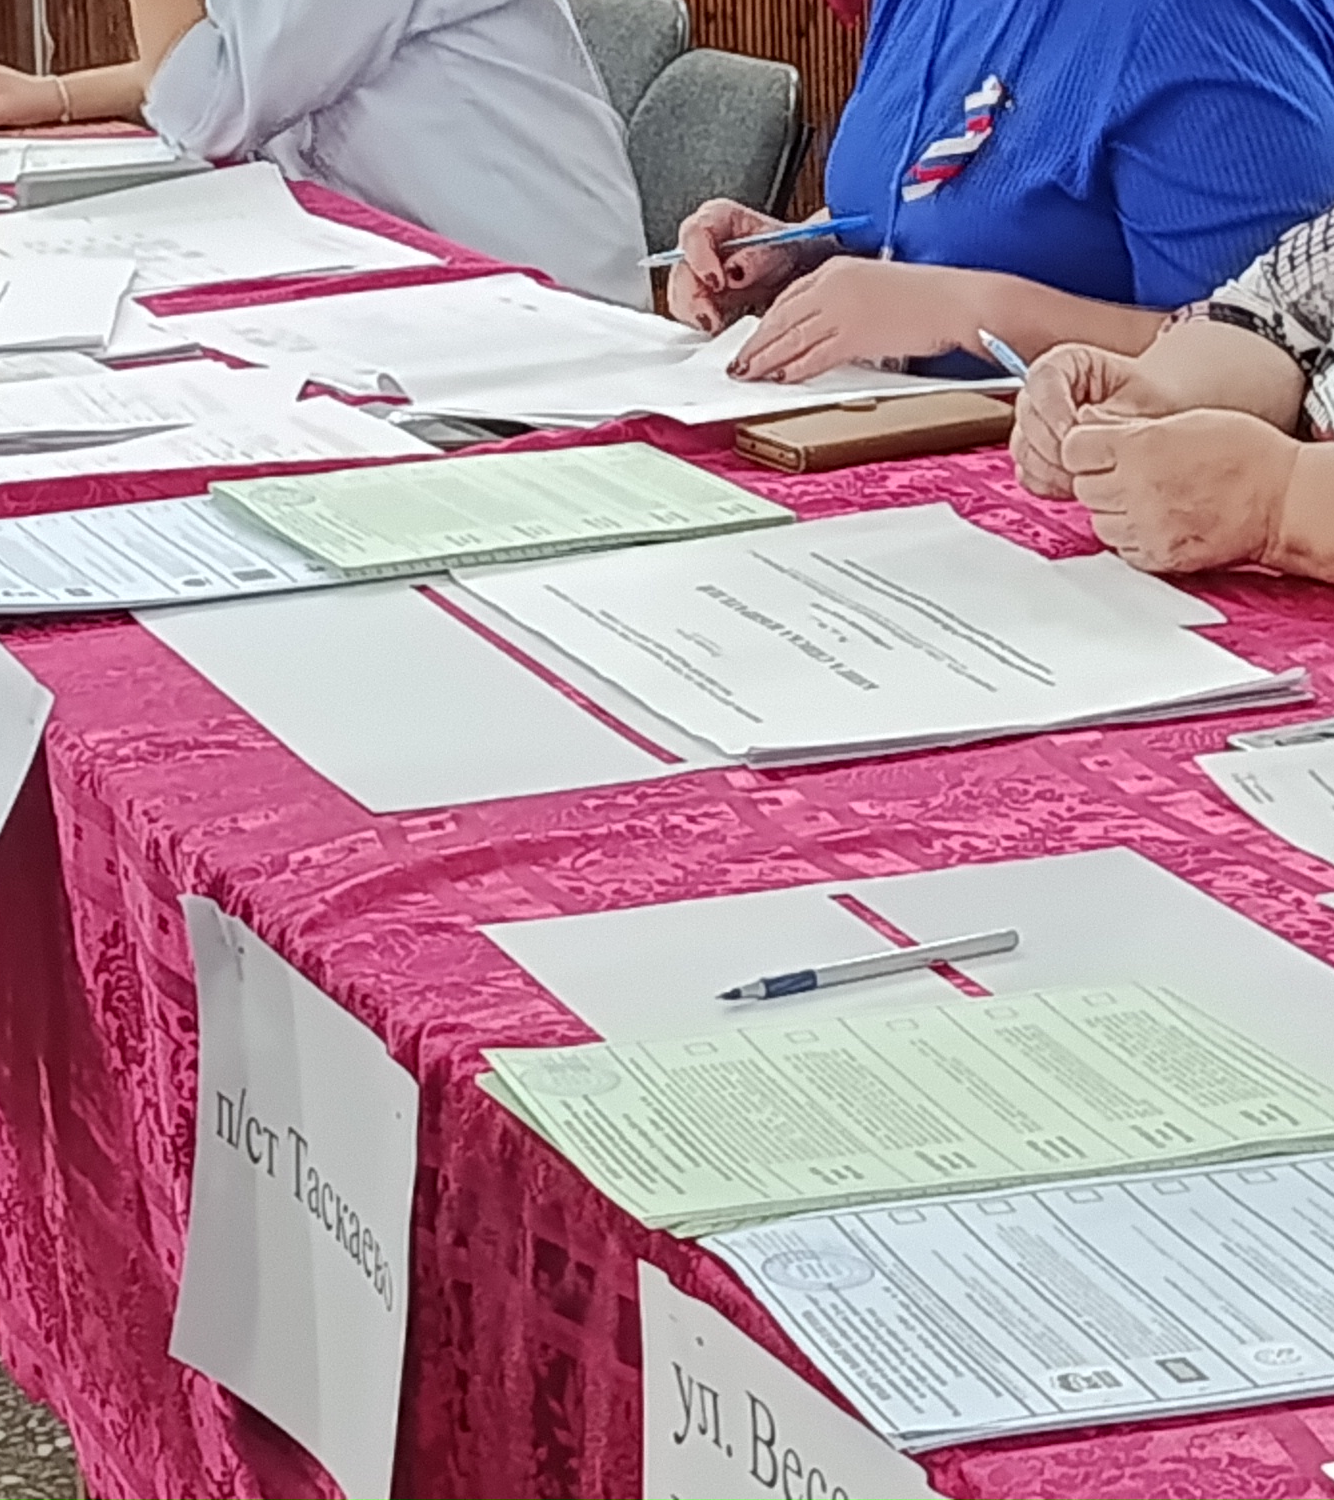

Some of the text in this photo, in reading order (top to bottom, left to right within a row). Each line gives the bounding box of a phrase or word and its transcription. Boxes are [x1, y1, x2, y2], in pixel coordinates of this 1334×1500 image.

[214, 1086, 280, 1178] п/ст
[288, 1127, 394, 1311] Таскаево
[671, 1360, 734, 1458] ул.
